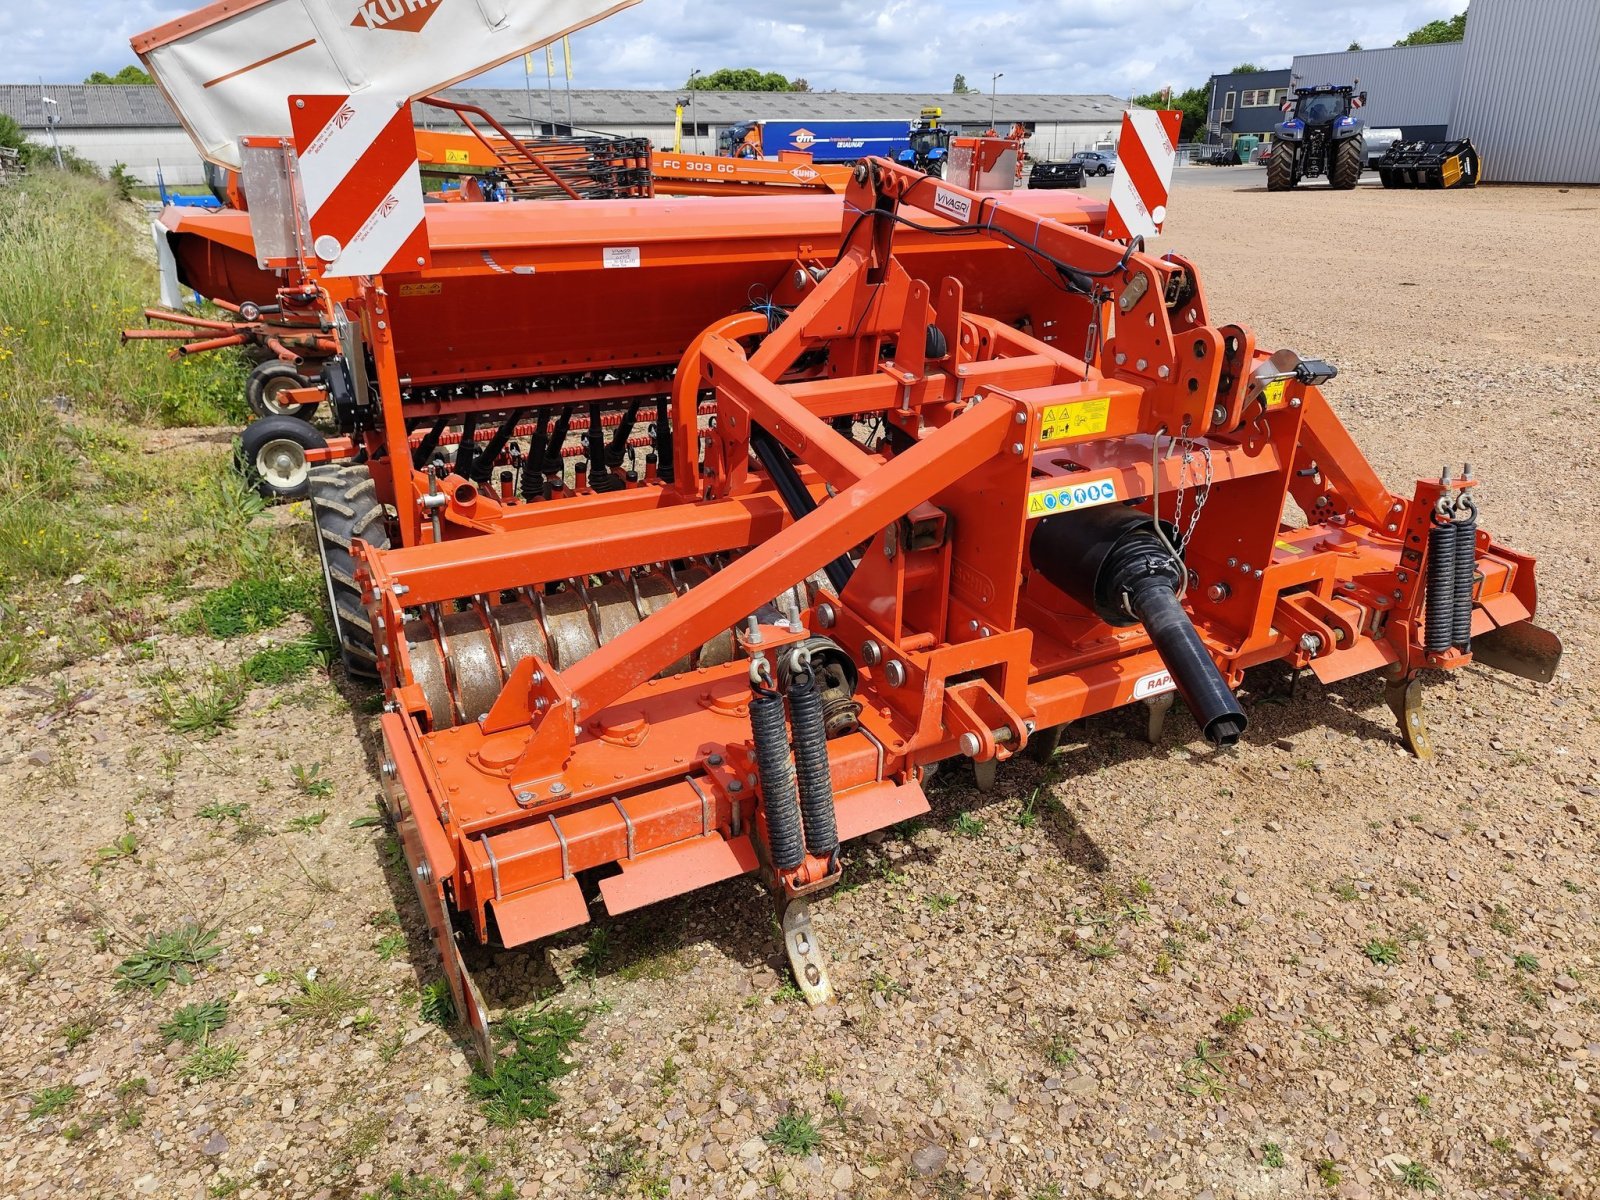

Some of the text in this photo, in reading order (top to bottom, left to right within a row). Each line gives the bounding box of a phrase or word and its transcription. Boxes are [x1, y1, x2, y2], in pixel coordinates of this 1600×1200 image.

[663, 160, 735, 173] FC 303 GC
